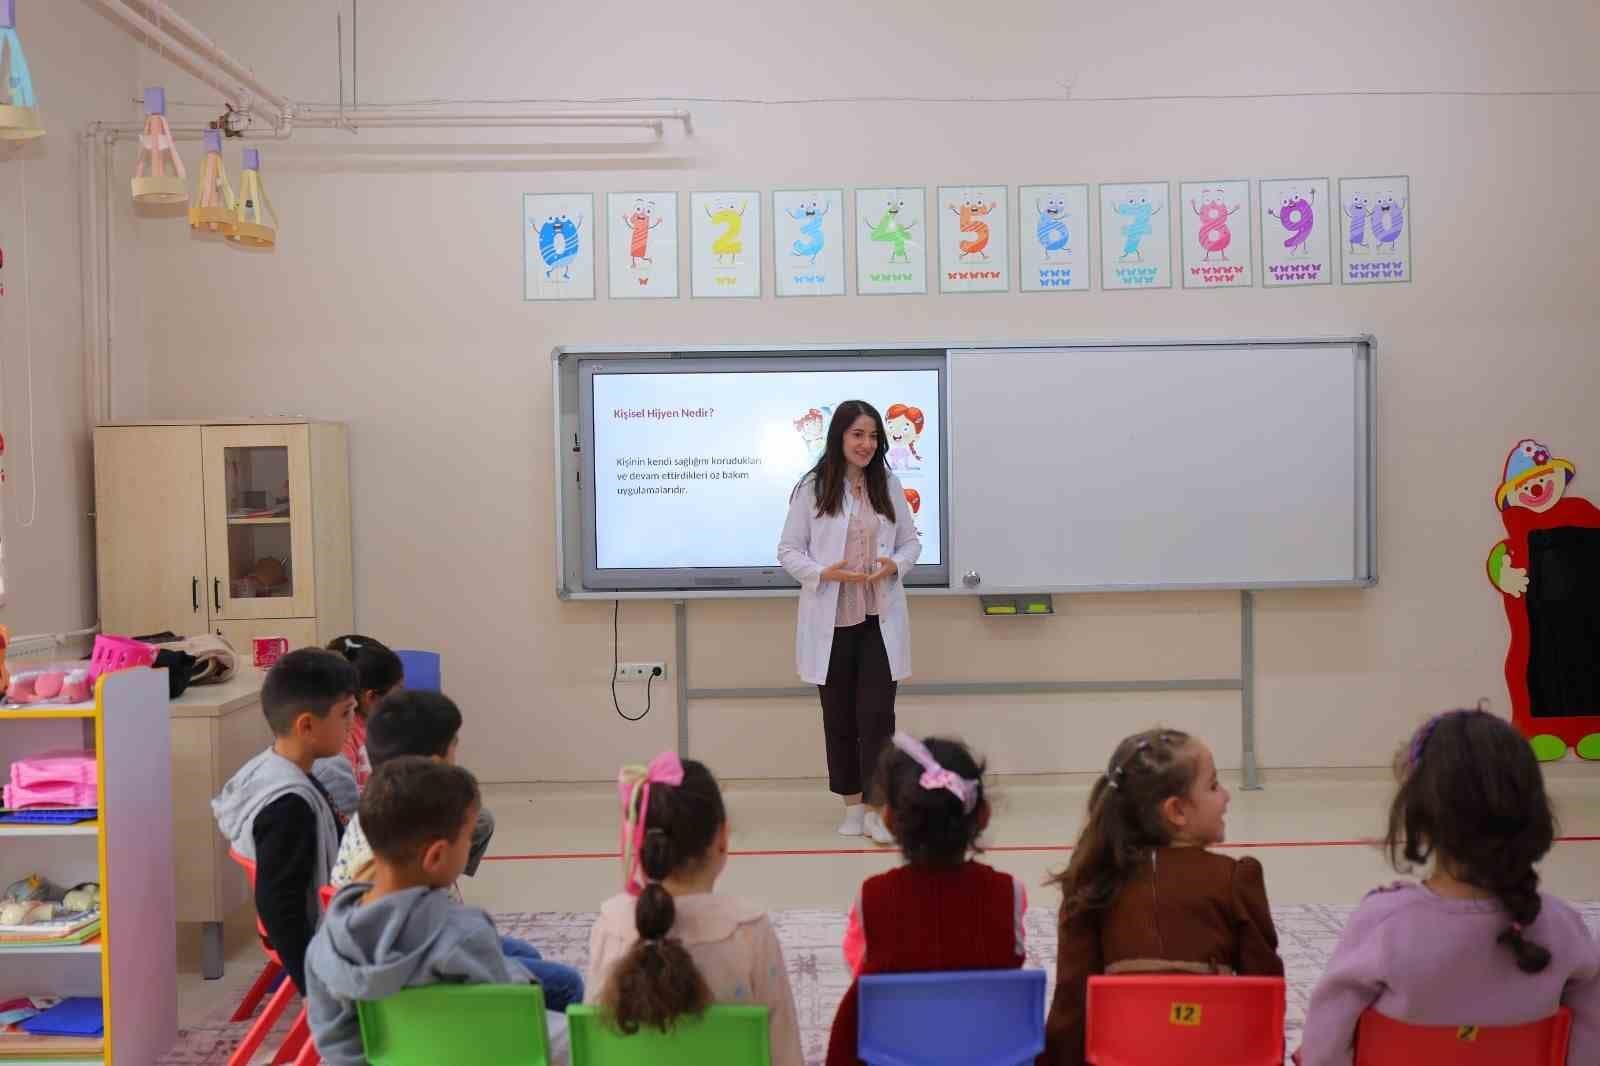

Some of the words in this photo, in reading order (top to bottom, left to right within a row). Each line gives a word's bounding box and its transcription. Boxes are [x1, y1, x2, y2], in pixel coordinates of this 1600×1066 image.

[538, 216, 579, 268] 0
[711, 208, 743, 255] 2
[793, 207, 825, 257] 3
[870, 206, 912, 257] 4
[959, 203, 990, 254] 5
[1037, 201, 1070, 251] 6
[1119, 202, 1152, 252] 7
[1199, 200, 1232, 251] 8
[1279, 198, 1314, 248] 9
[1349, 199, 1404, 245] 10
[613, 407, 645, 420] Kişisel
[647, 407, 680, 421] Hijyen
[681, 406, 715, 418] Nedir?
[616, 457, 646, 469] Kişinin
[647, 456, 672, 467] kendi
[616, 472, 627, 481] ve
[629, 471, 660, 481] devam
[661, 470, 708, 481] ettirdikleri
[722, 470, 750, 480] bakım
[1174, 1005, 1195, 1021] 12
